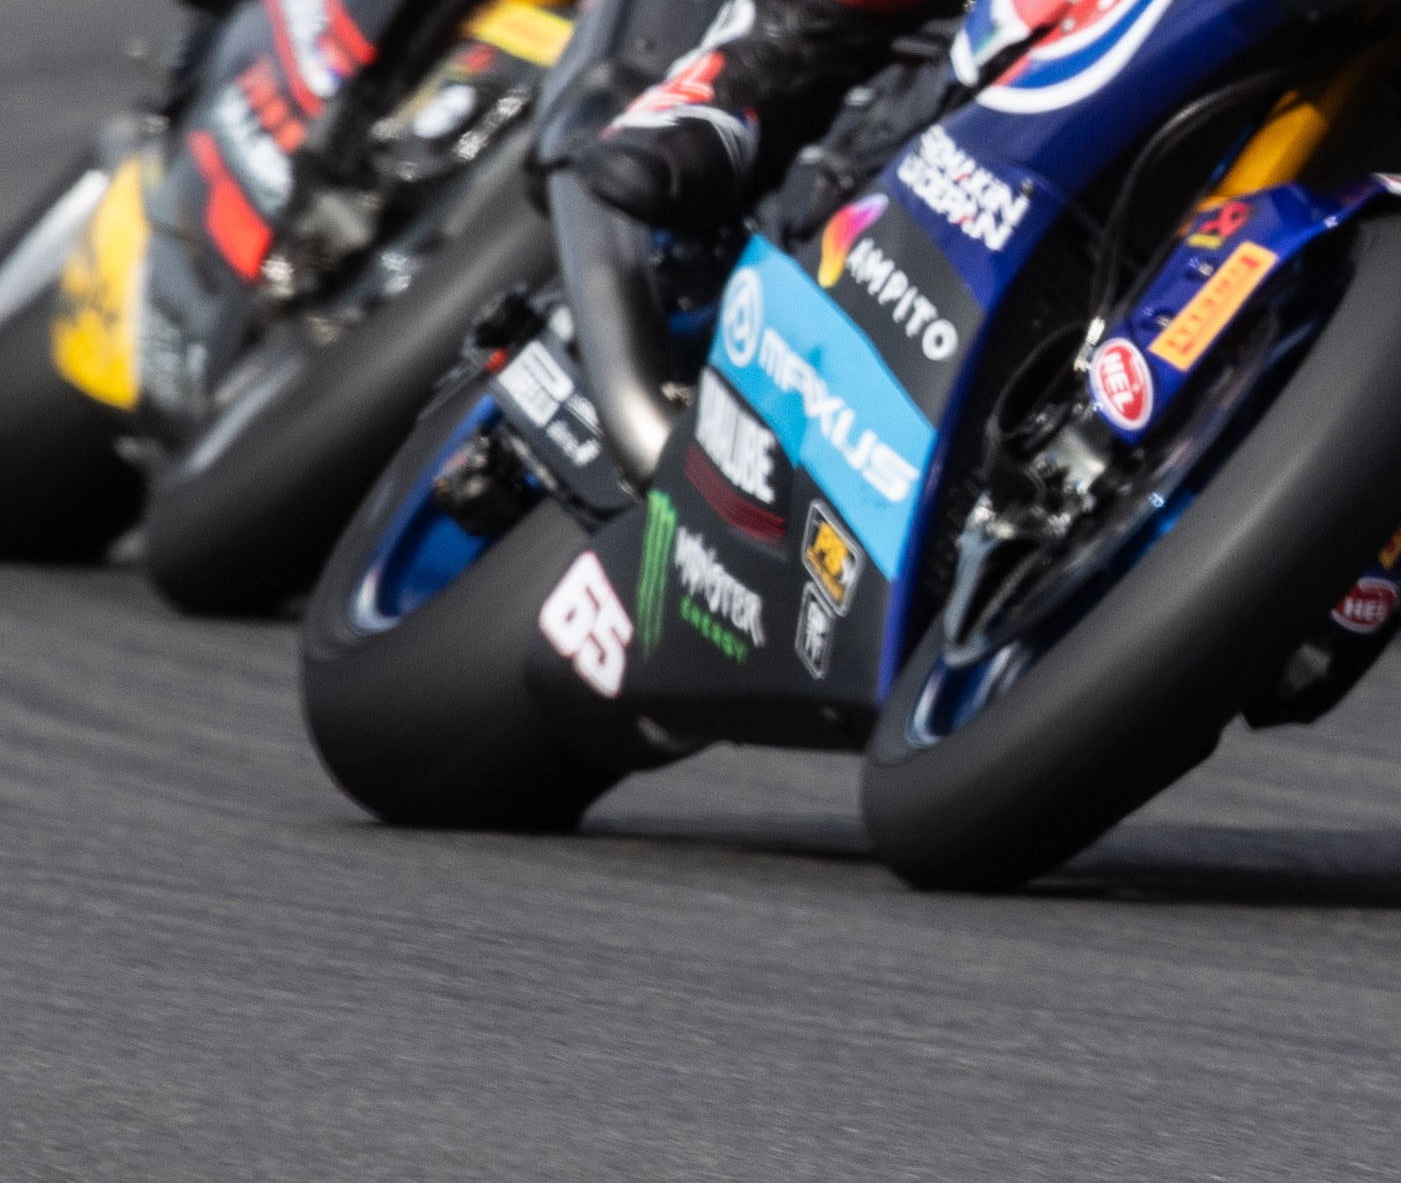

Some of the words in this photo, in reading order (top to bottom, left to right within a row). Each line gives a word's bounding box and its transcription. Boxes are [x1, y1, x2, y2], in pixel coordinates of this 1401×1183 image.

[846, 237, 959, 361] AMPITO
[1101, 353, 1135, 412] HEL
[538, 550, 634, 699] 65
